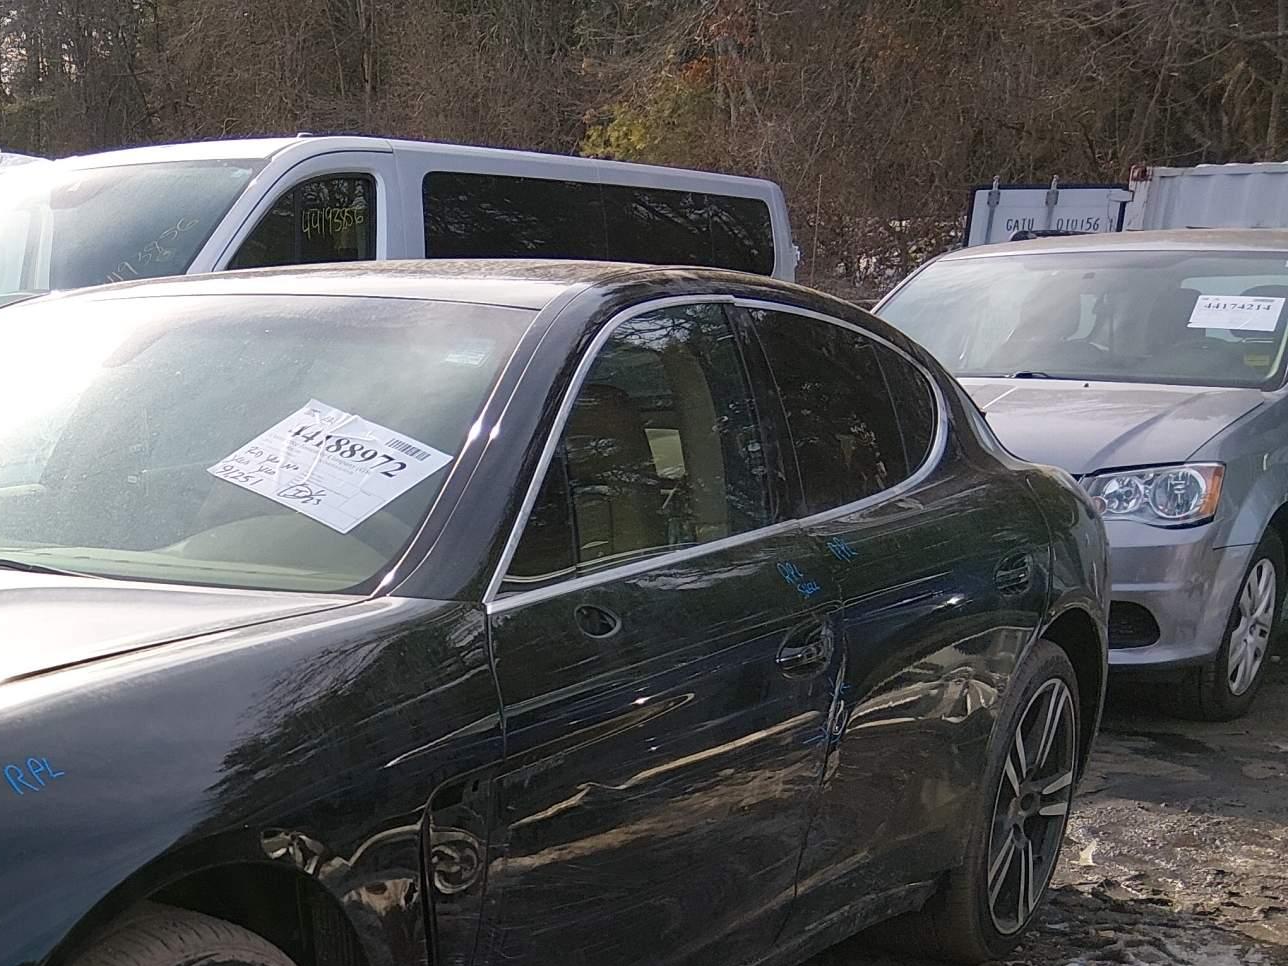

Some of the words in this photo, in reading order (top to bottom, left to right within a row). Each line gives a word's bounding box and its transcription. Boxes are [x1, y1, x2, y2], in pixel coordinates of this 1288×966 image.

[1006, 218, 1034, 231] GATU
[1056, 217, 1100, 231] 010156
[1203, 302, 1273, 311] 44174214
[288, 423, 407, 478] 44188972
